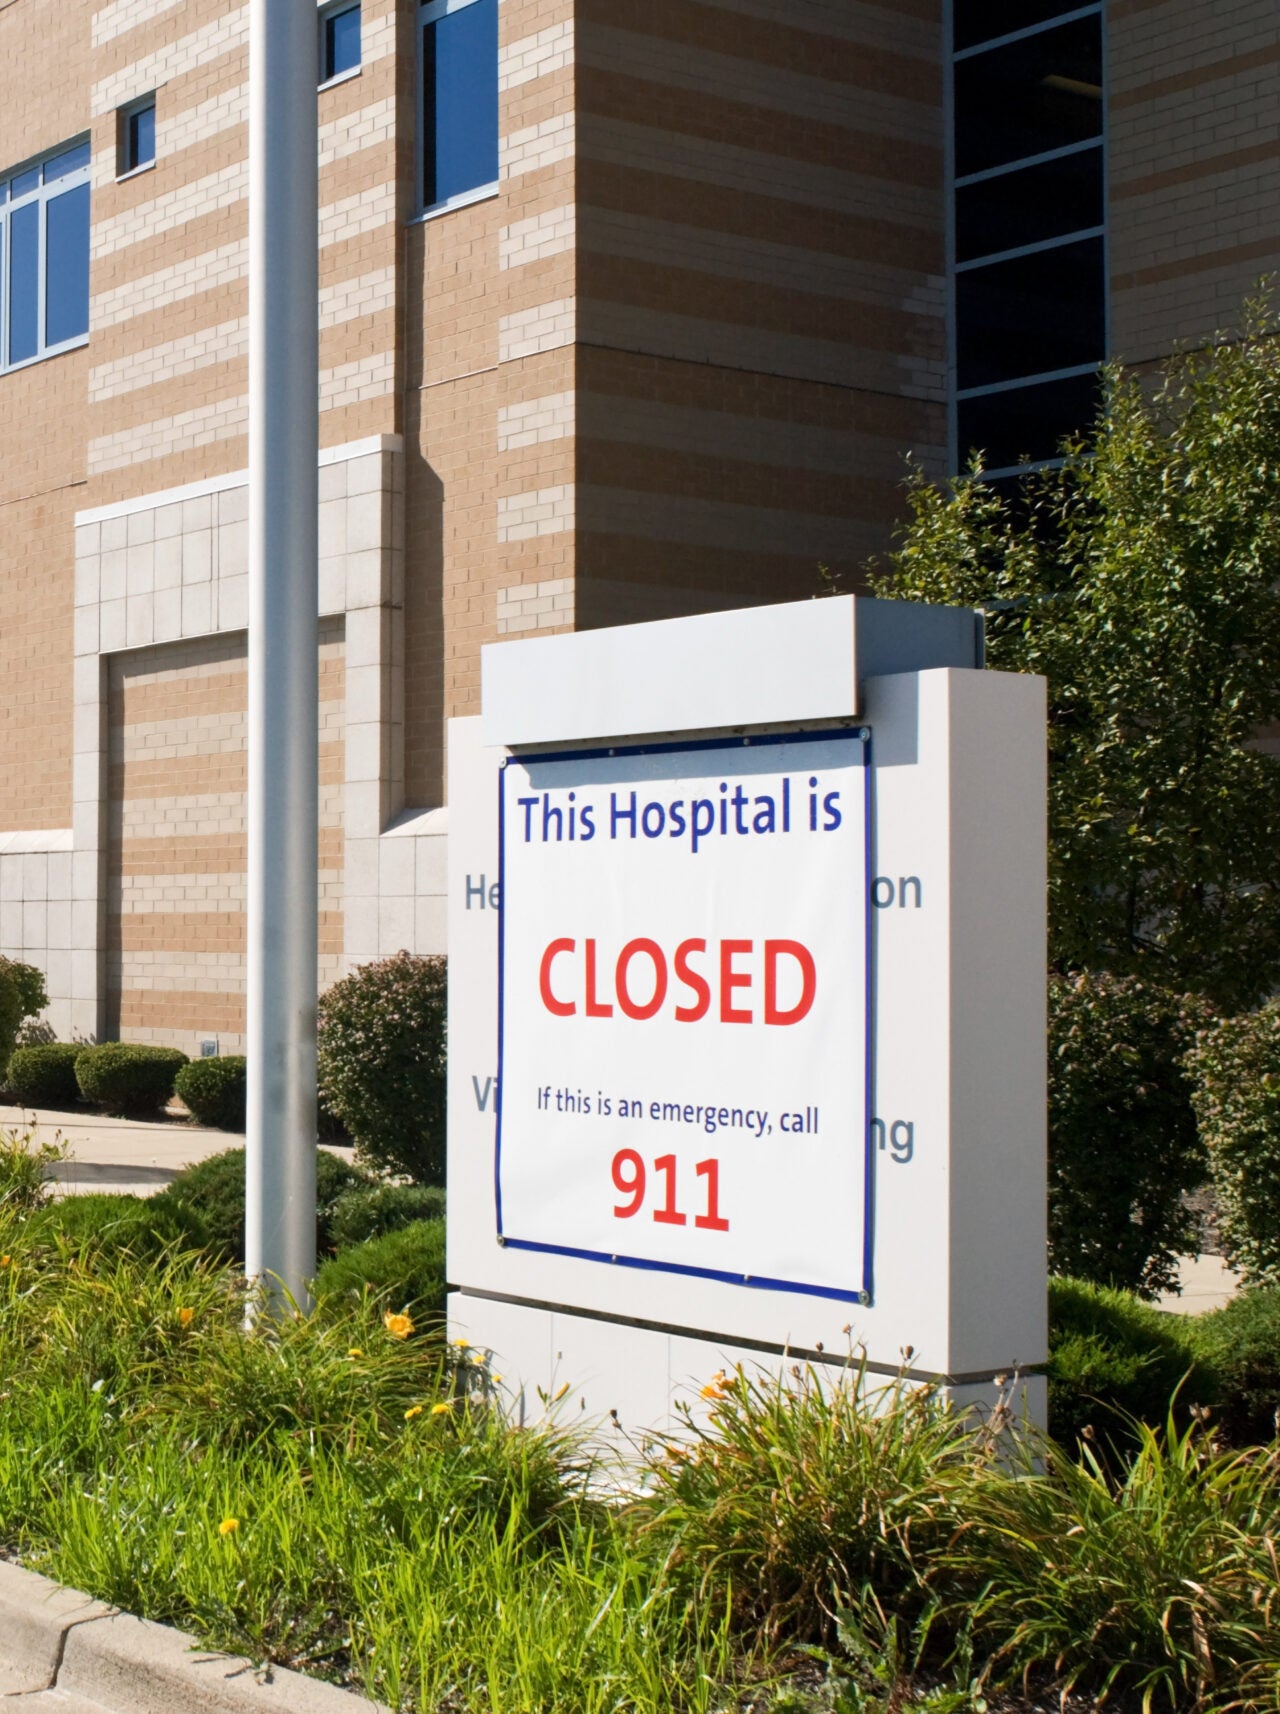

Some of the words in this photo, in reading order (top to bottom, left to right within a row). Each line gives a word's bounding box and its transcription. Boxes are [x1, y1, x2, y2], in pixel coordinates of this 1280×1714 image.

[518, 793, 595, 843] This
[610, 777, 790, 854] Hospital
[809, 776, 842, 832] is
[539, 937, 817, 1026] CLOSED
[537, 1085, 552, 1110] If
[555, 1088, 591, 1114] this
[597, 1091, 612, 1116] is
[618, 1099, 643, 1119] an
[649, 1101, 773, 1138] emergency,
[780, 1106, 819, 1134] call
[611, 1148, 730, 1232] 911
